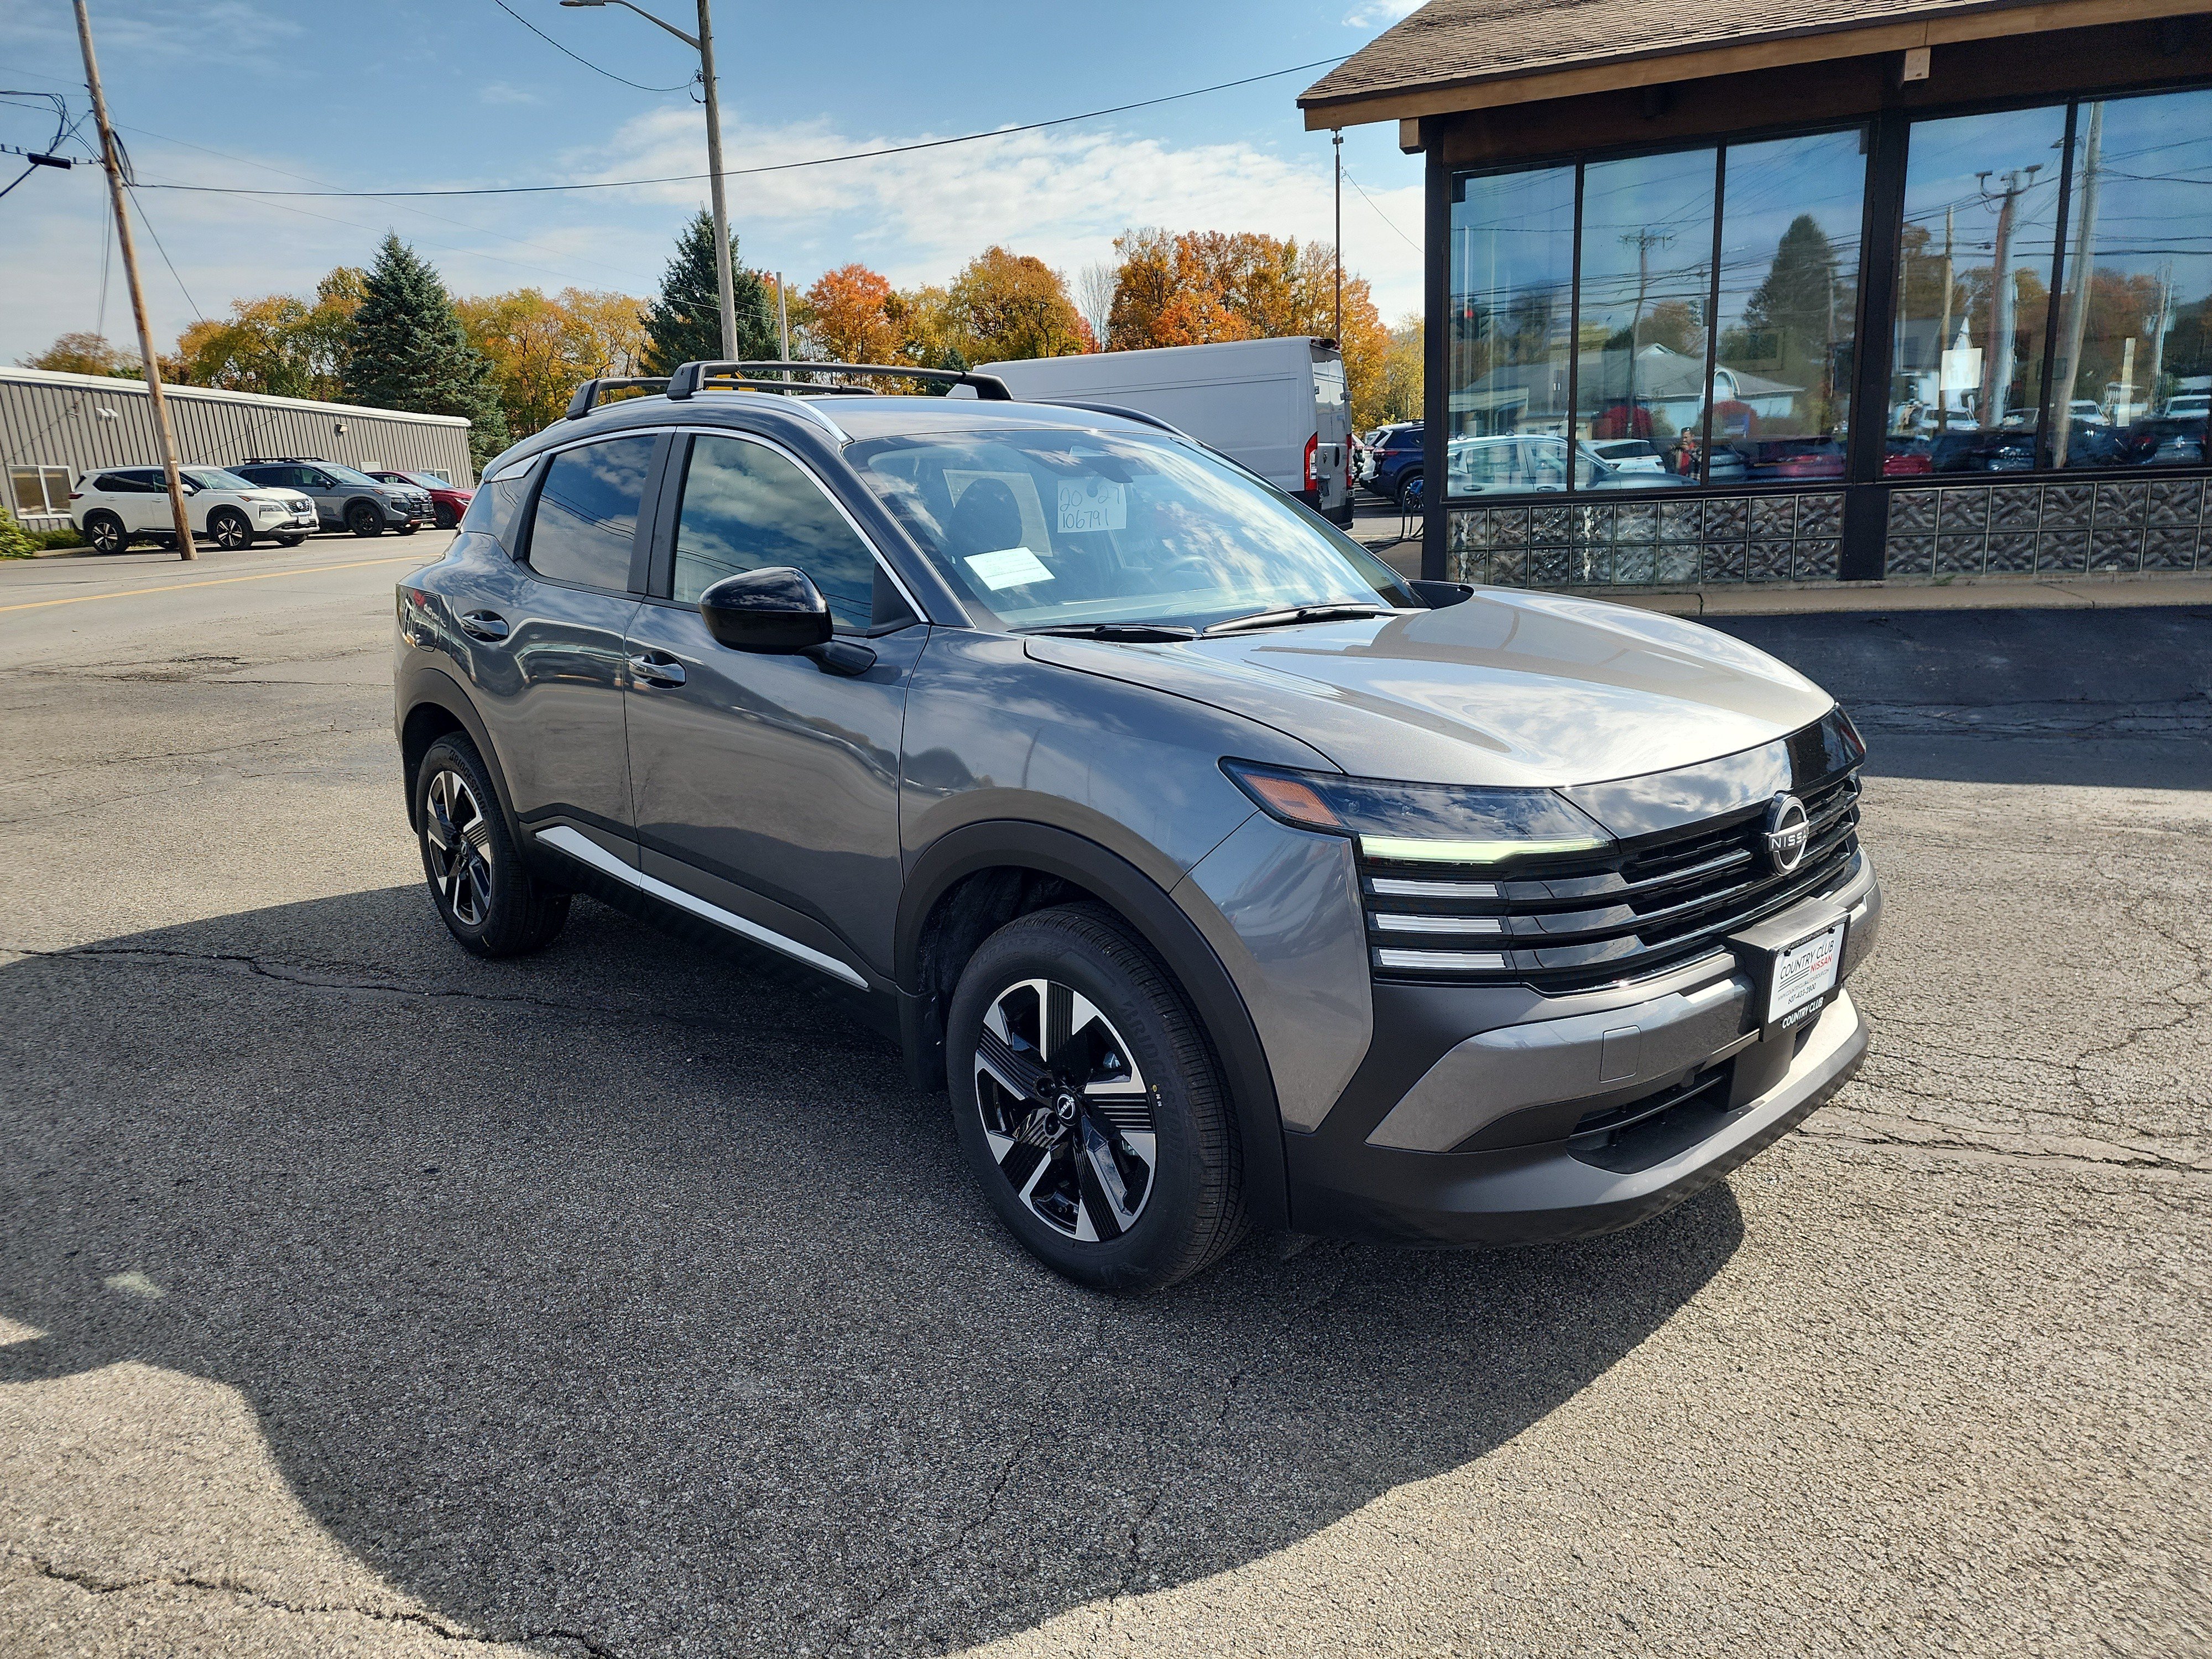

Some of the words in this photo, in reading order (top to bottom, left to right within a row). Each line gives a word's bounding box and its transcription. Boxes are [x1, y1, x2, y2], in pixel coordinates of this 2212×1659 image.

[1063, 509, 1109, 529] 106791
[1780, 949, 1816, 979] COUNTRY
[1816, 940, 1834, 959] CLUB
[1810, 953, 1833, 973] NISSAN
[1782, 1004, 1810, 1029] COUNTRY
[1809, 996, 1824, 1013] CLUB
